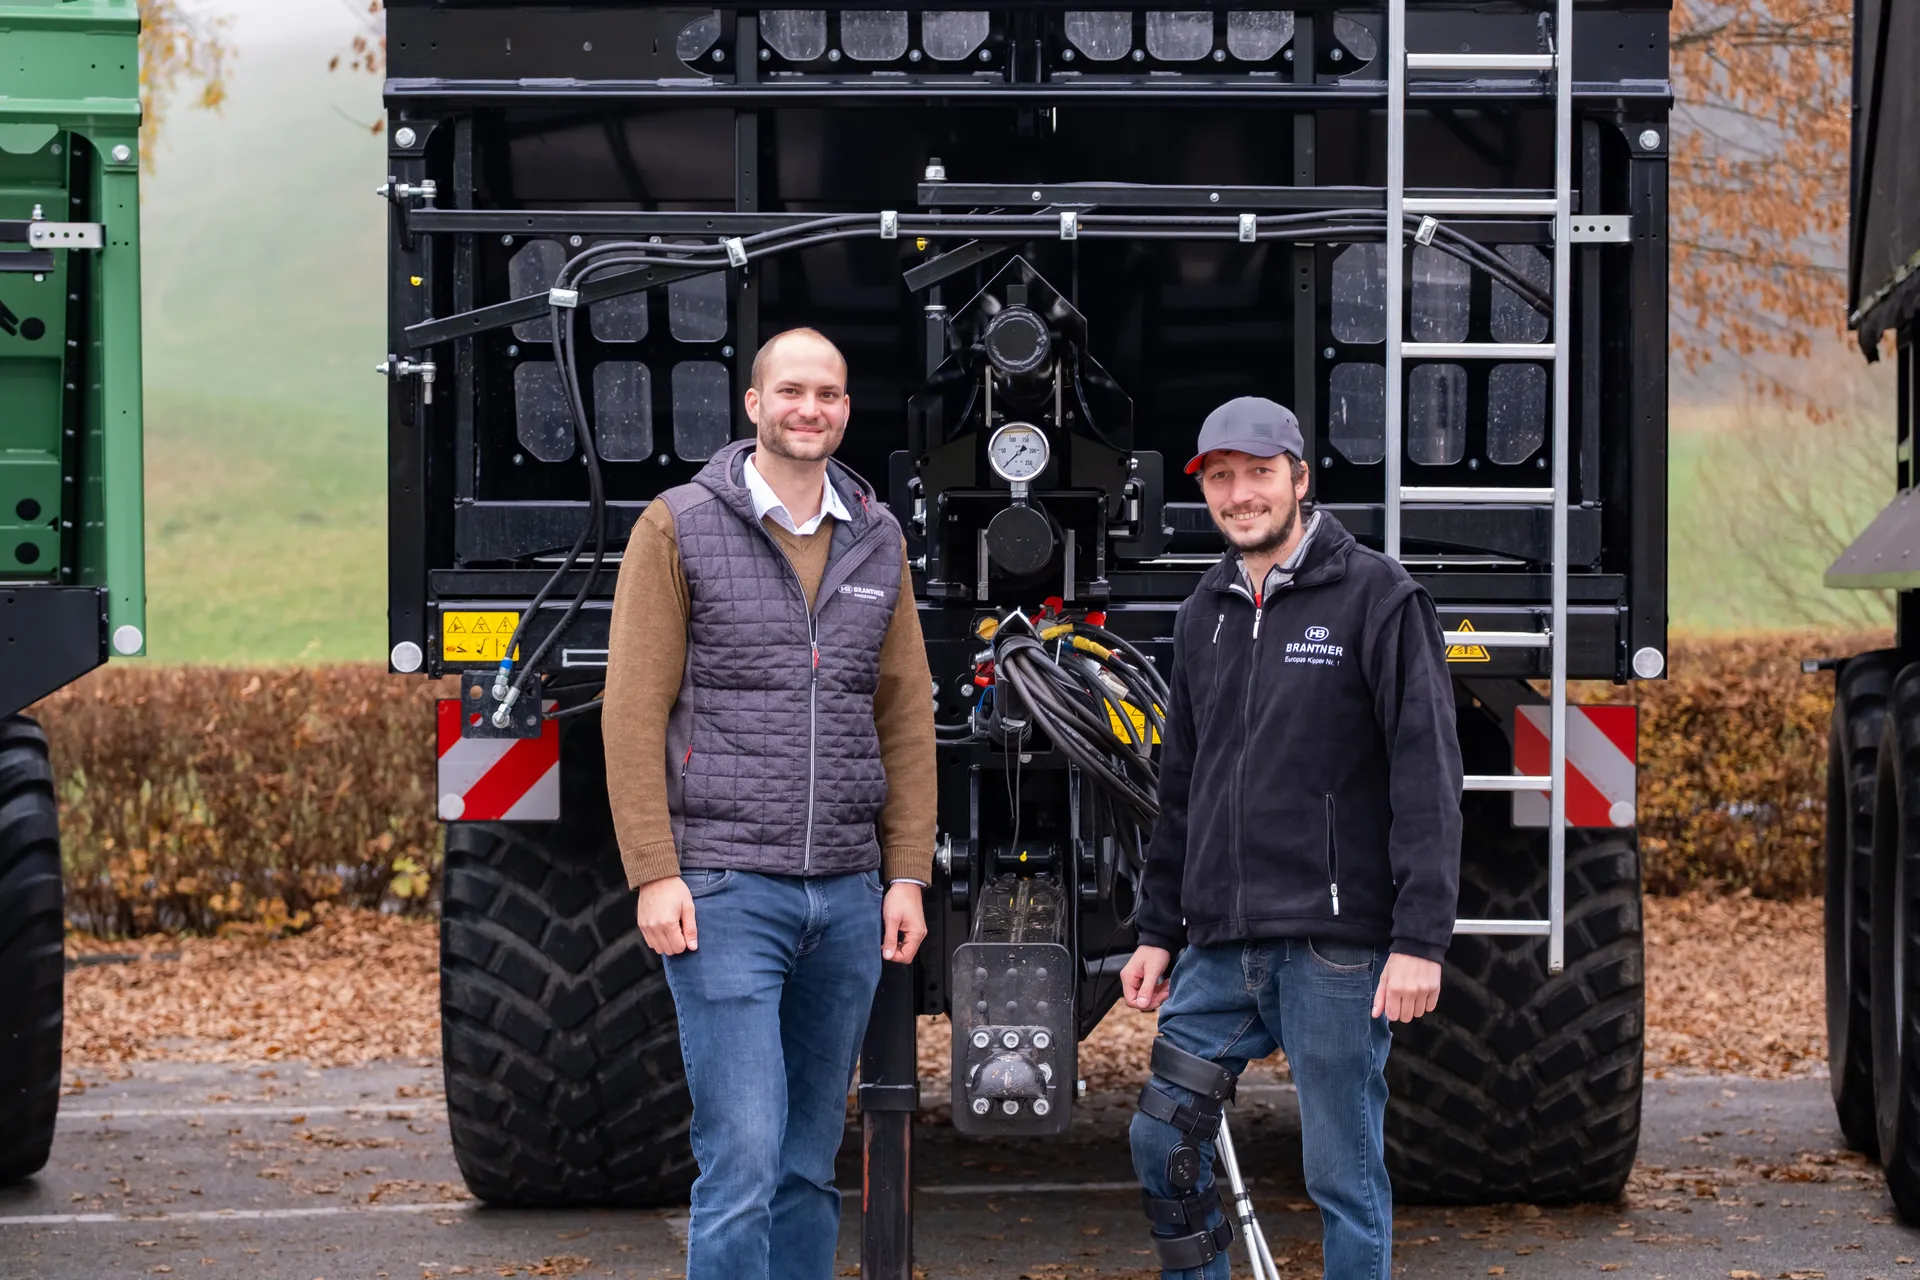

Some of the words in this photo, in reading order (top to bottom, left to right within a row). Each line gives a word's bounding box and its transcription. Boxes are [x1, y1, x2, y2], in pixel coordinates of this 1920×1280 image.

[853, 586, 884, 598] BRANTNER
[1309, 628, 1326, 638] HB
[1285, 643, 1344, 656] BRANTNER
[1284, 655, 1307, 664] Europas
[1307, 656, 1325, 665] Kipper
[1325, 658, 1335, 666] Nr.
